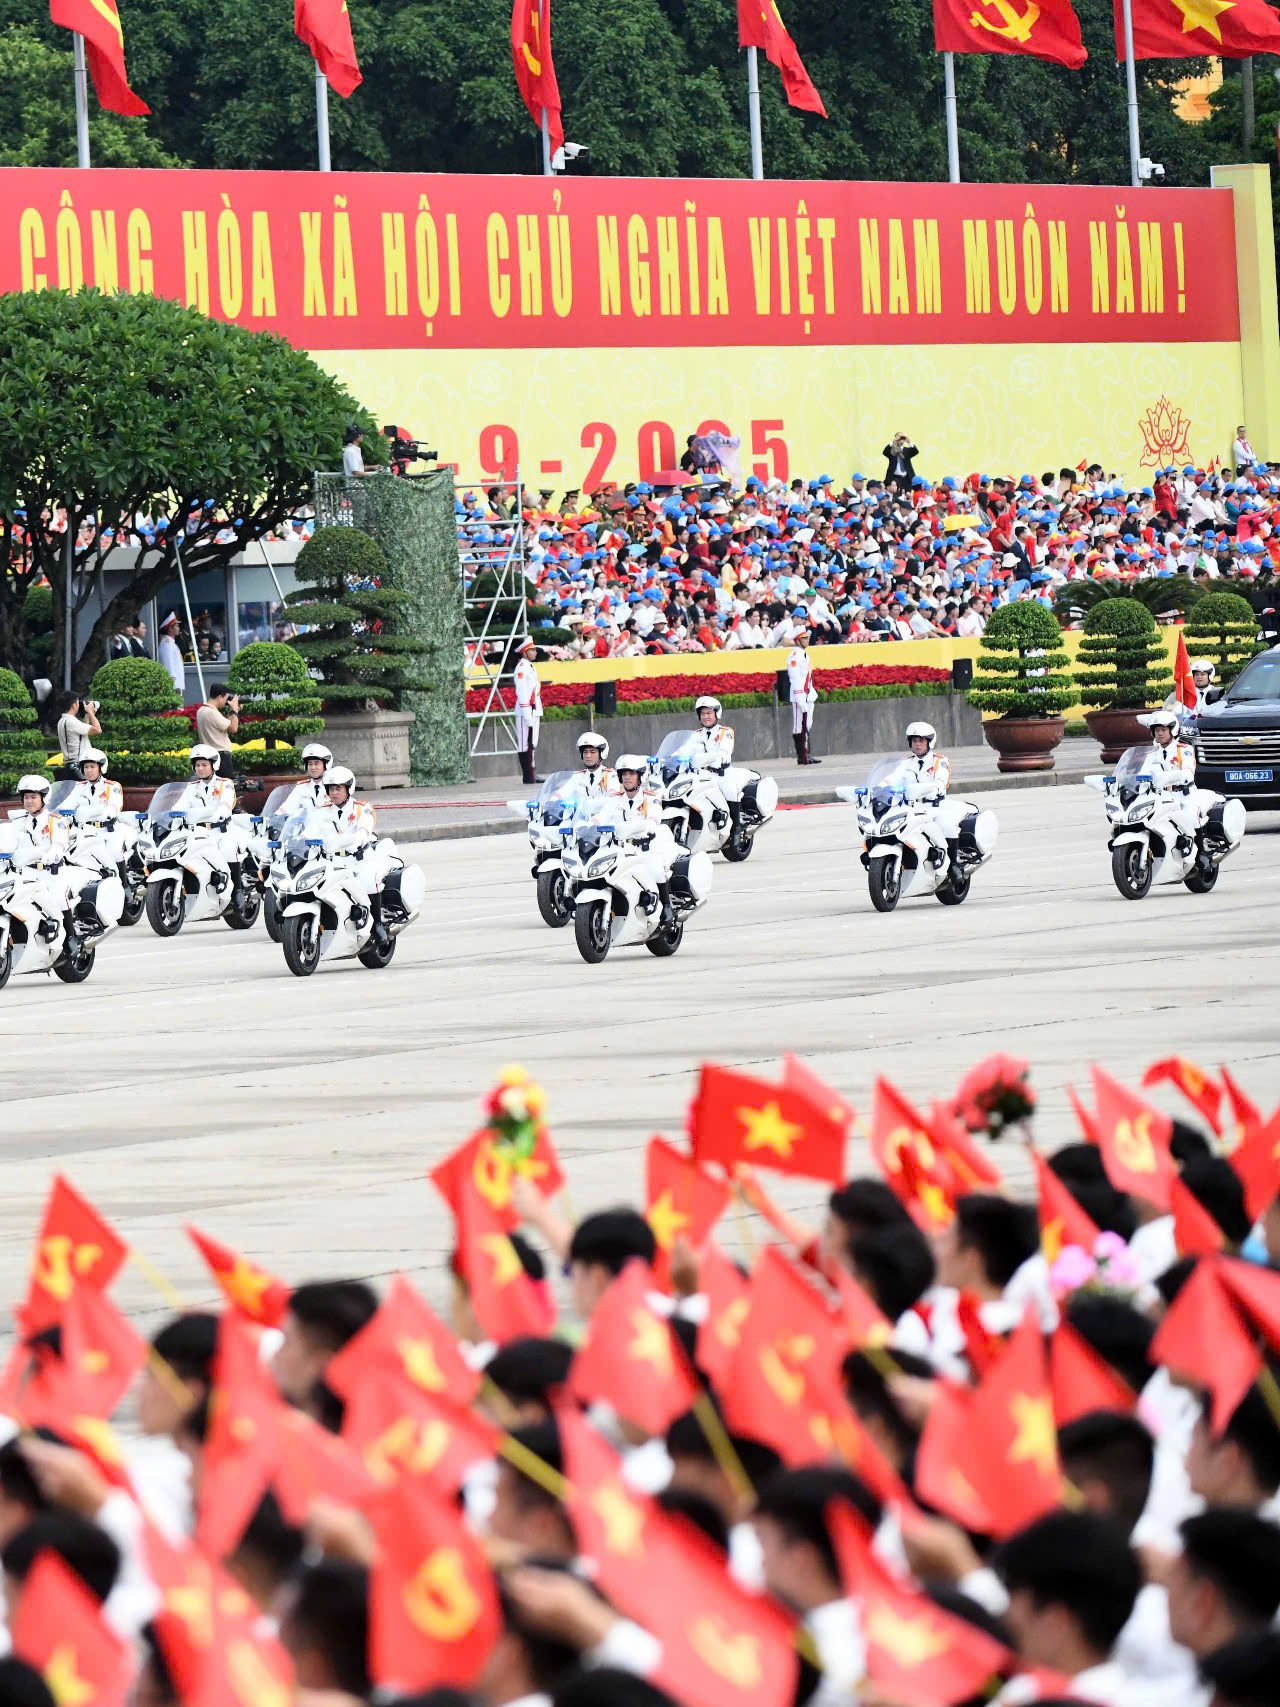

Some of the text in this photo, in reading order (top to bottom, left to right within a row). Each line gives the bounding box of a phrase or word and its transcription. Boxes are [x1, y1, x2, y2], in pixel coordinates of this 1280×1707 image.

[182, 193, 277, 319] HÒA
[299, 194, 358, 317] XÃ
[381, 193, 461, 337] HỘI
[486, 188, 573, 318] CHỦ
[596, 199, 729, 317] NGHĨA
[748, 199, 836, 335] VIỆT
[859, 218, 942, 314] NAM
[963, 202, 1069, 315] MUÔN
